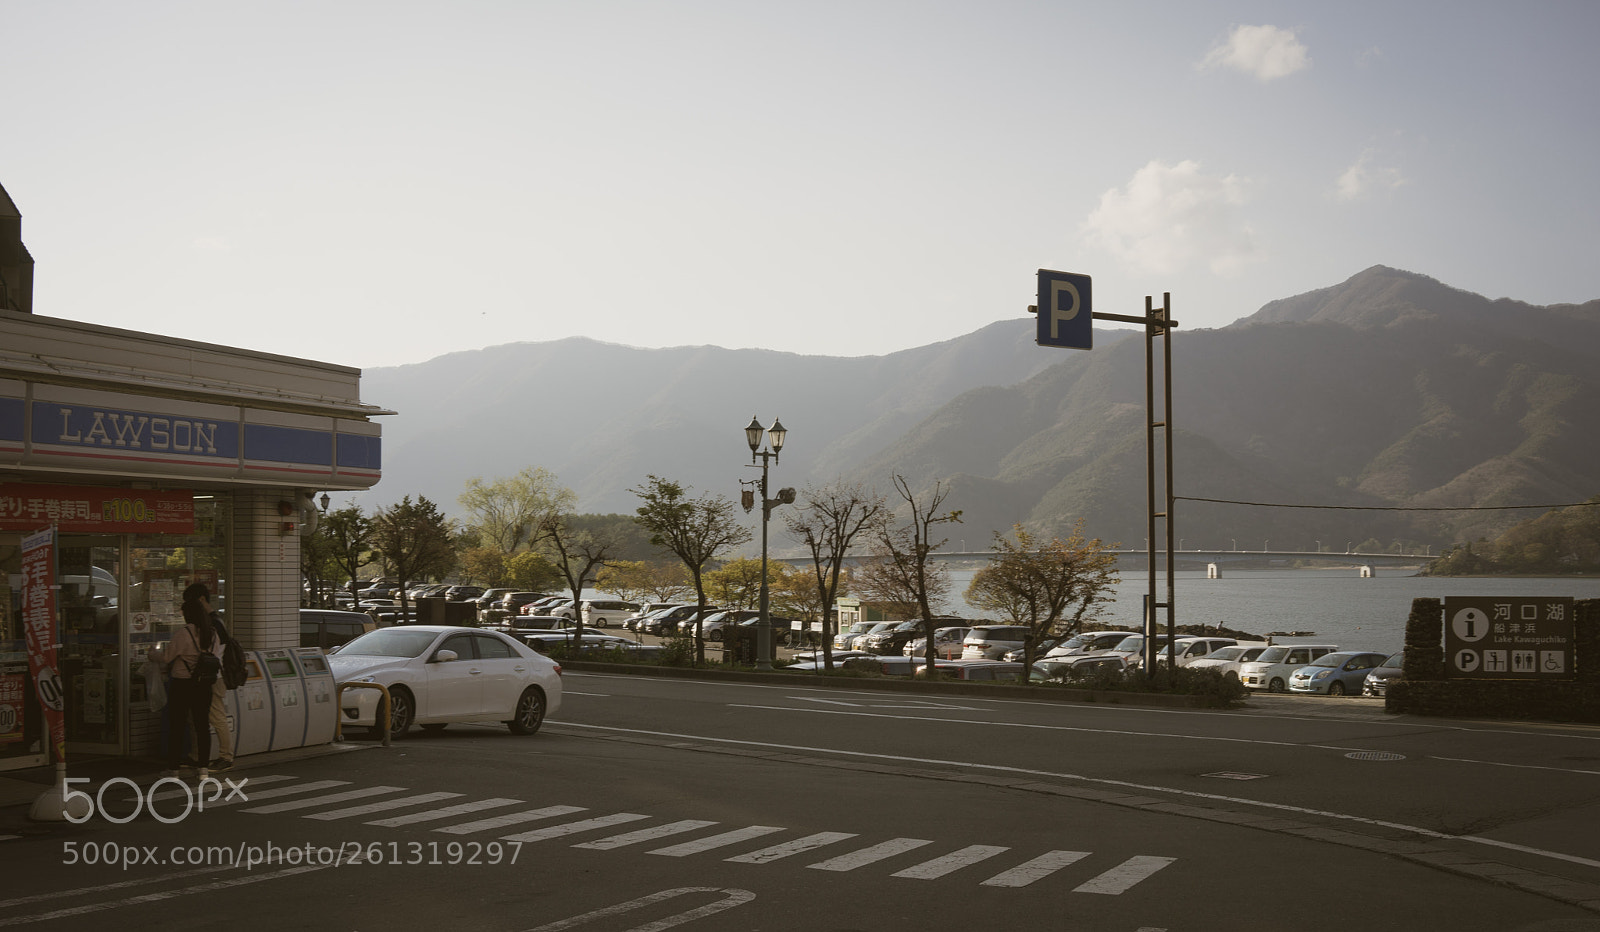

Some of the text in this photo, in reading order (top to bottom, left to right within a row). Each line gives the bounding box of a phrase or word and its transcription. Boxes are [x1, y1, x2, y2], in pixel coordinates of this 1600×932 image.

[1051, 280, 1080, 338] P
[59, 408, 218, 455] LAWSON
[1494, 603, 1565, 621] 河口湖
[1514, 636, 1567, 645] Kawaguchiko
[1461, 653, 1475, 668] P
